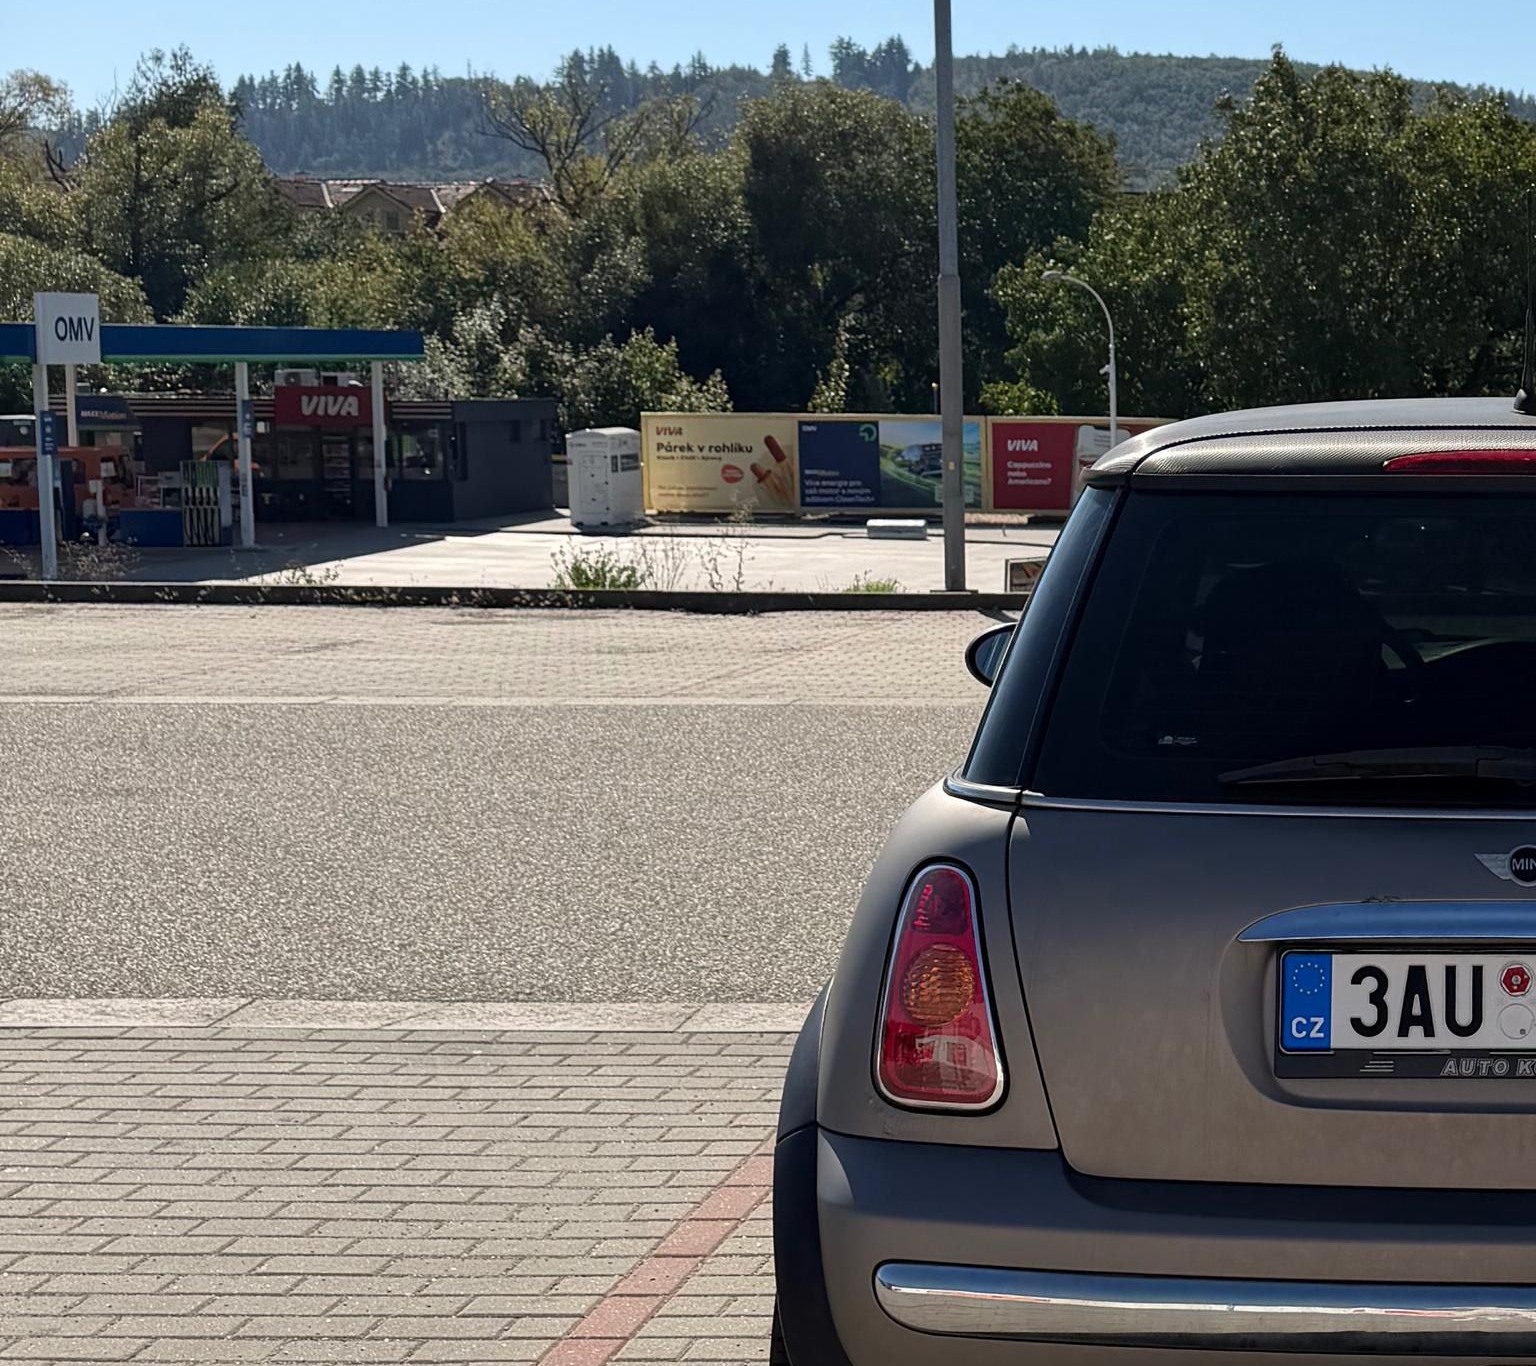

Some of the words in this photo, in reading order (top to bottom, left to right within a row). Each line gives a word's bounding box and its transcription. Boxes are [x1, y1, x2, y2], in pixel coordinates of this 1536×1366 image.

[55, 316, 95, 342] OMV
[301, 395, 359, 417] VIVA
[655, 426, 683, 436] VIVA
[656, 441, 694, 453] Párek
[697, 444, 705, 453] v
[708, 442, 753, 454] rohlíku
[1007, 439, 1038, 452] VIVA
[1349, 964, 1484, 1038] 3AU
[1291, 1016, 1325, 1038] CZ
[1440, 1057, 1510, 1077] AUTO
